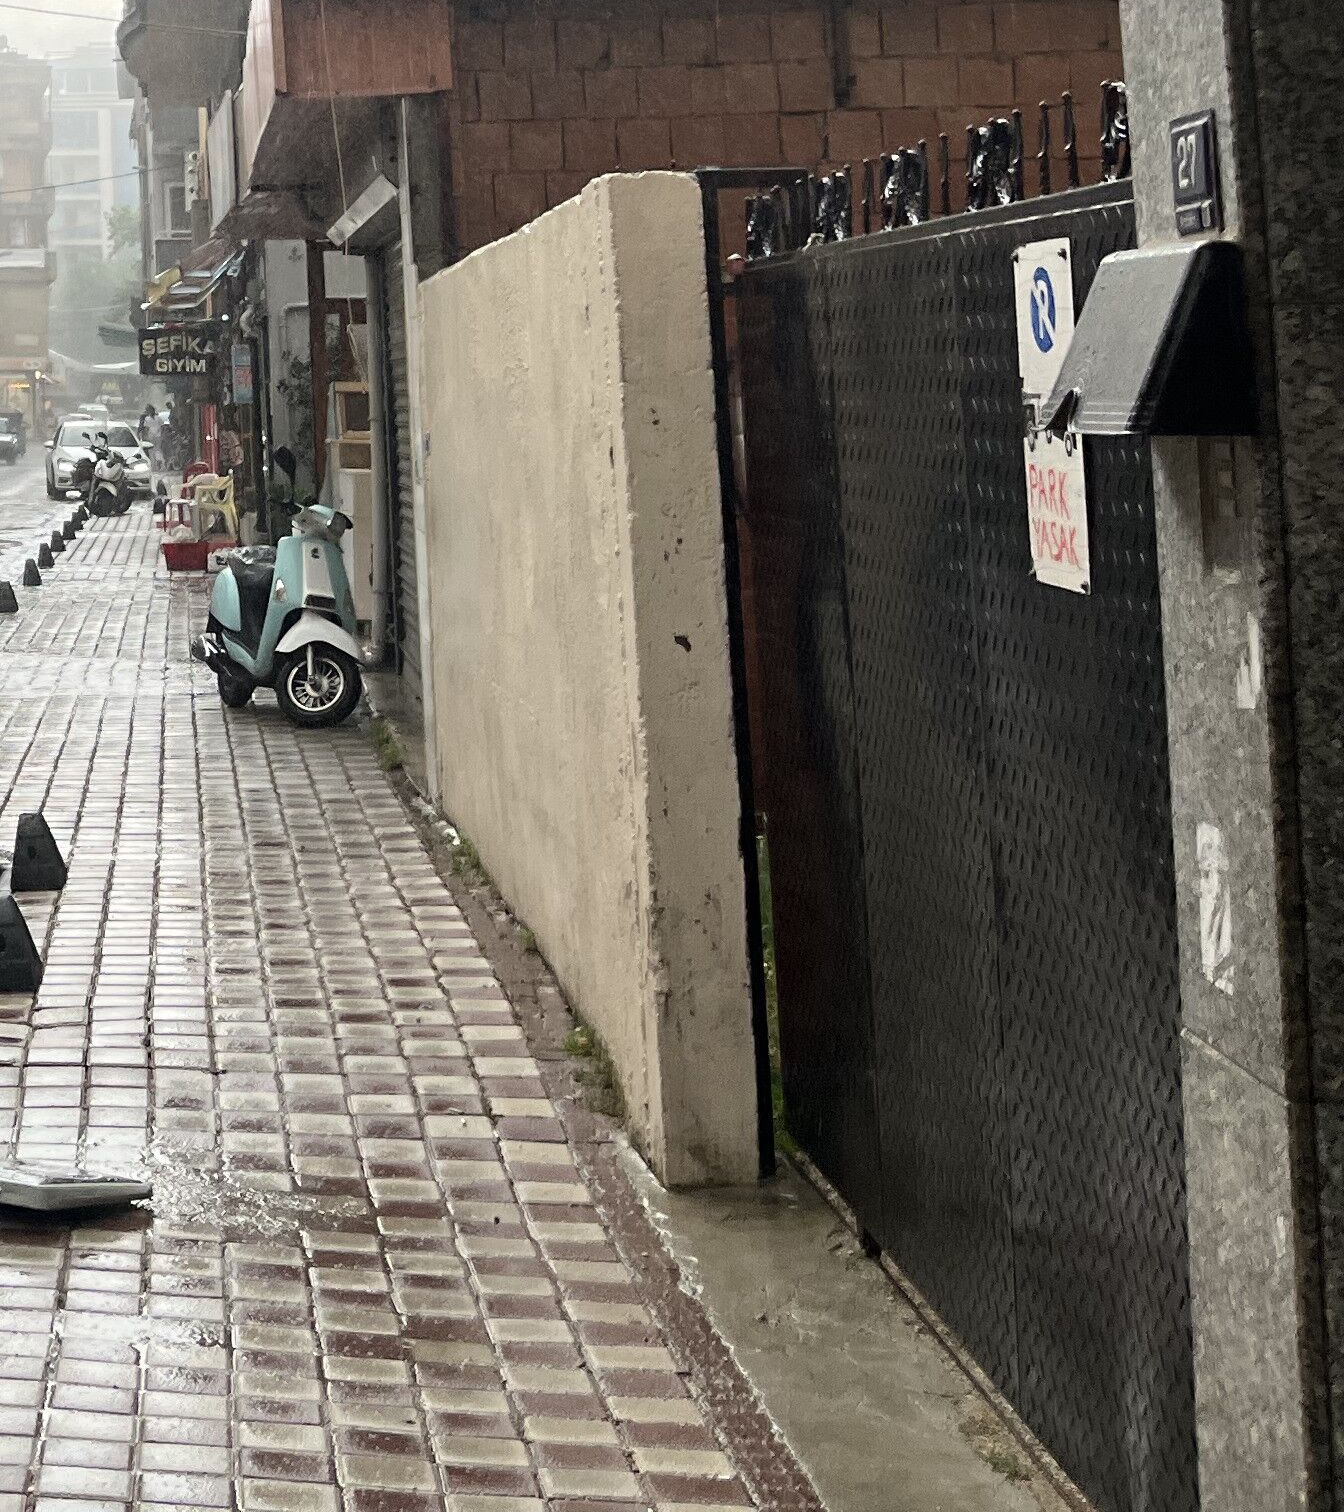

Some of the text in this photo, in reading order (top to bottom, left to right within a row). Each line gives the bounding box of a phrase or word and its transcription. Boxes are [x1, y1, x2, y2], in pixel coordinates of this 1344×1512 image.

[1176, 133, 1197, 189] 27
[1028, 463, 1071, 520] PARK
[1031, 516, 1083, 571] YASAK
